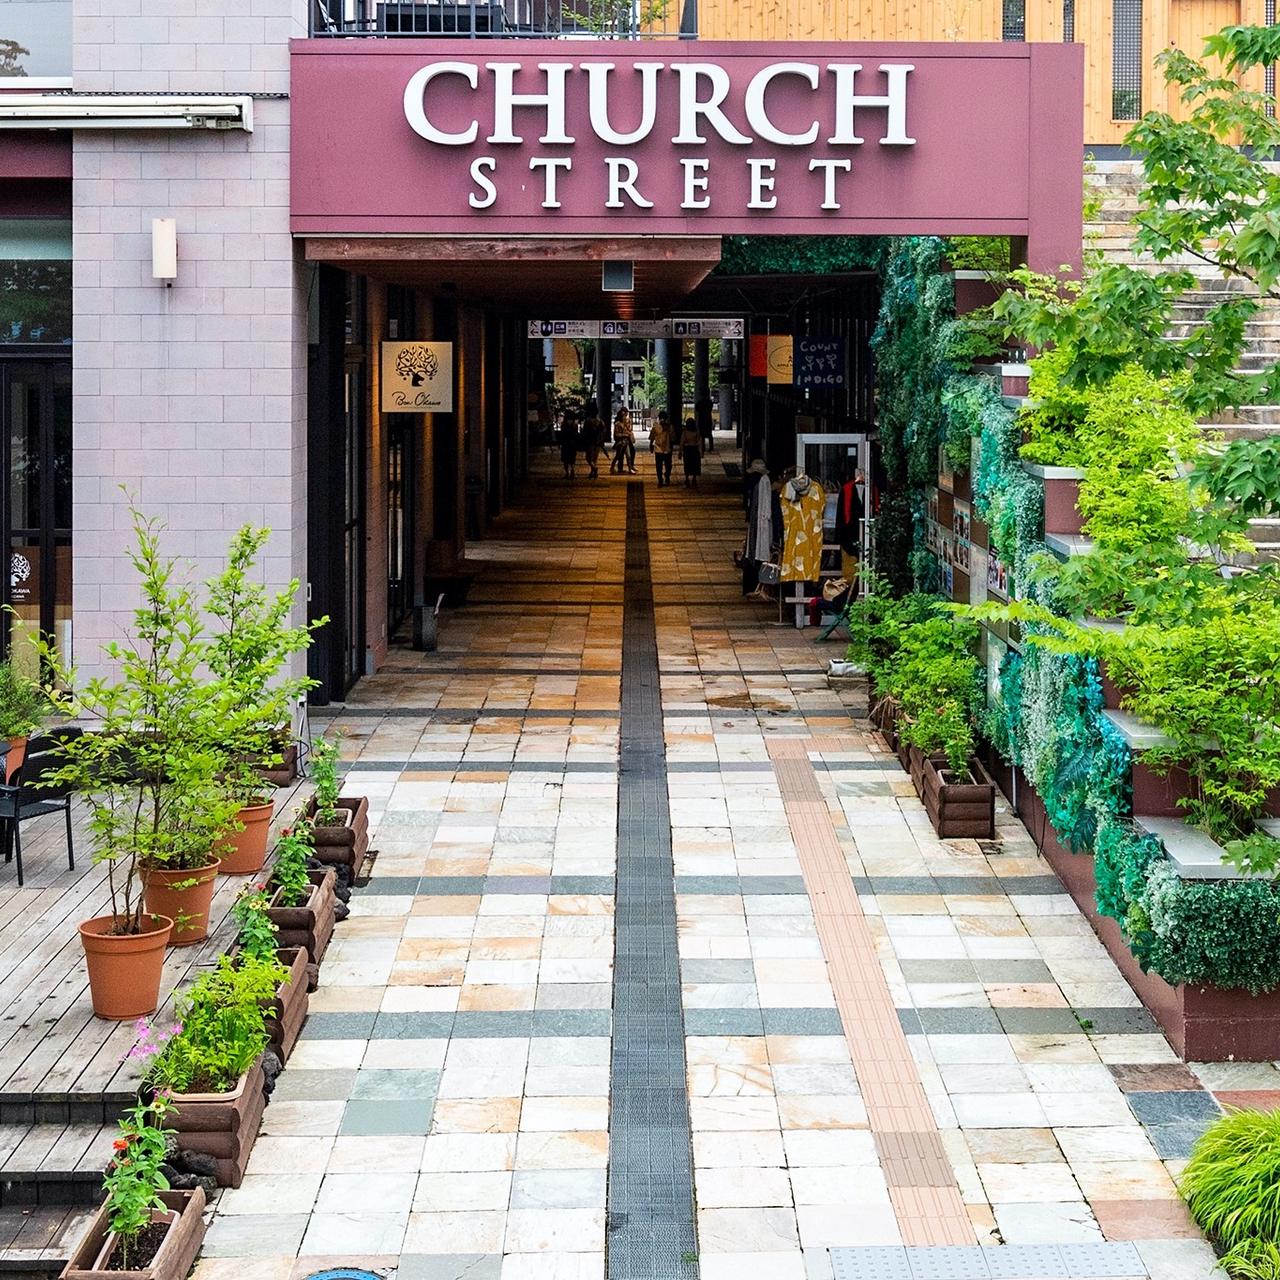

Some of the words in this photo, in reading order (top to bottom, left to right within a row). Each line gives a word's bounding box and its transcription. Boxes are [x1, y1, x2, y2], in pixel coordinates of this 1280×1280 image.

[403, 61, 917, 146] CHURCH
[468, 156, 852, 210] STREET
[797, 375, 843, 385] INDIGO
